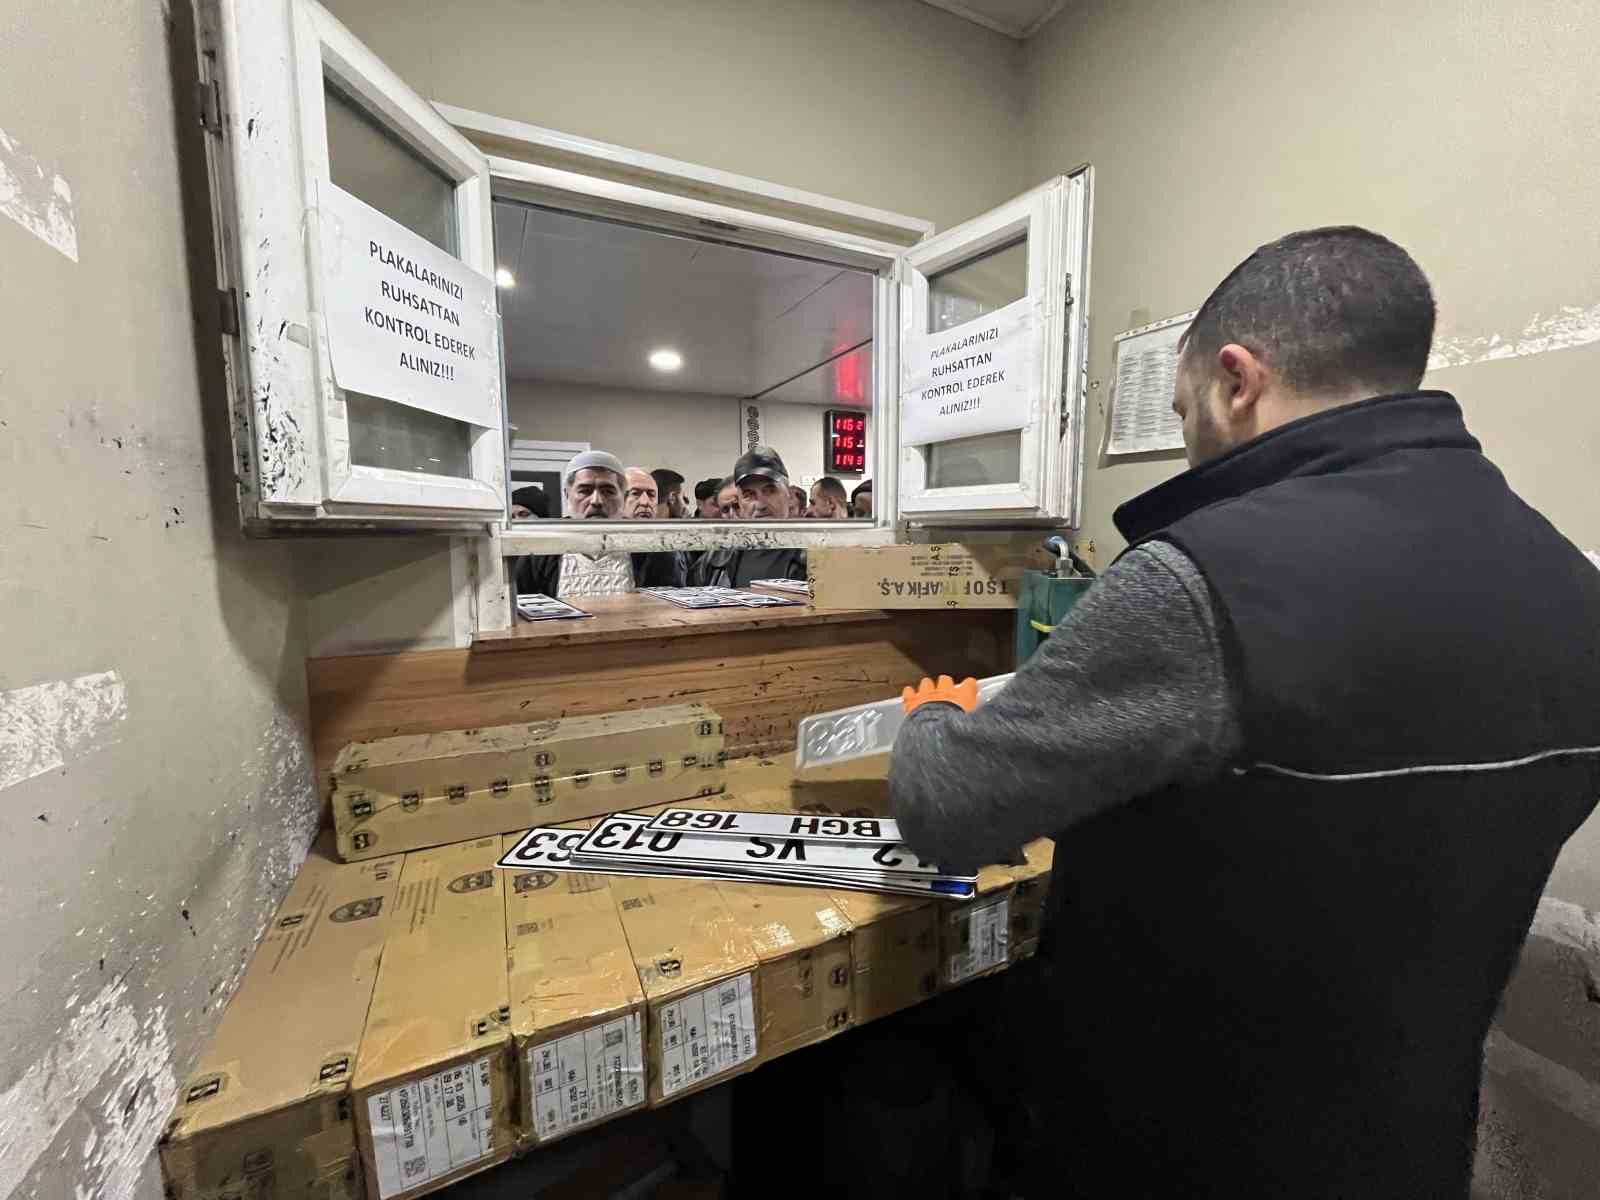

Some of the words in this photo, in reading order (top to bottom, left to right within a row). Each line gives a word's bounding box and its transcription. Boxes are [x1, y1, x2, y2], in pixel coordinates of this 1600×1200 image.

[369, 240, 464, 301] PLAKALARINIZI
[381, 280, 460, 327] RUHSATTAN
[365, 306, 431, 345] KONTROL
[434, 332, 476, 361] EDEREK
[930, 327, 999, 361] PLAKALARINIZI
[400, 352, 455, 381] ALINIZ!!!
[931, 351, 992, 378] RUHSATTAN
[921, 380, 964, 401] KONTROL
[967, 369, 1006, 390] EDEREK
[939, 396, 980, 417] ALINIZ!!!
[660, 811, 740, 830] 168
[789, 817, 882, 838] BGH
[592, 822, 684, 852] 013
[746, 836, 807, 861] VS
